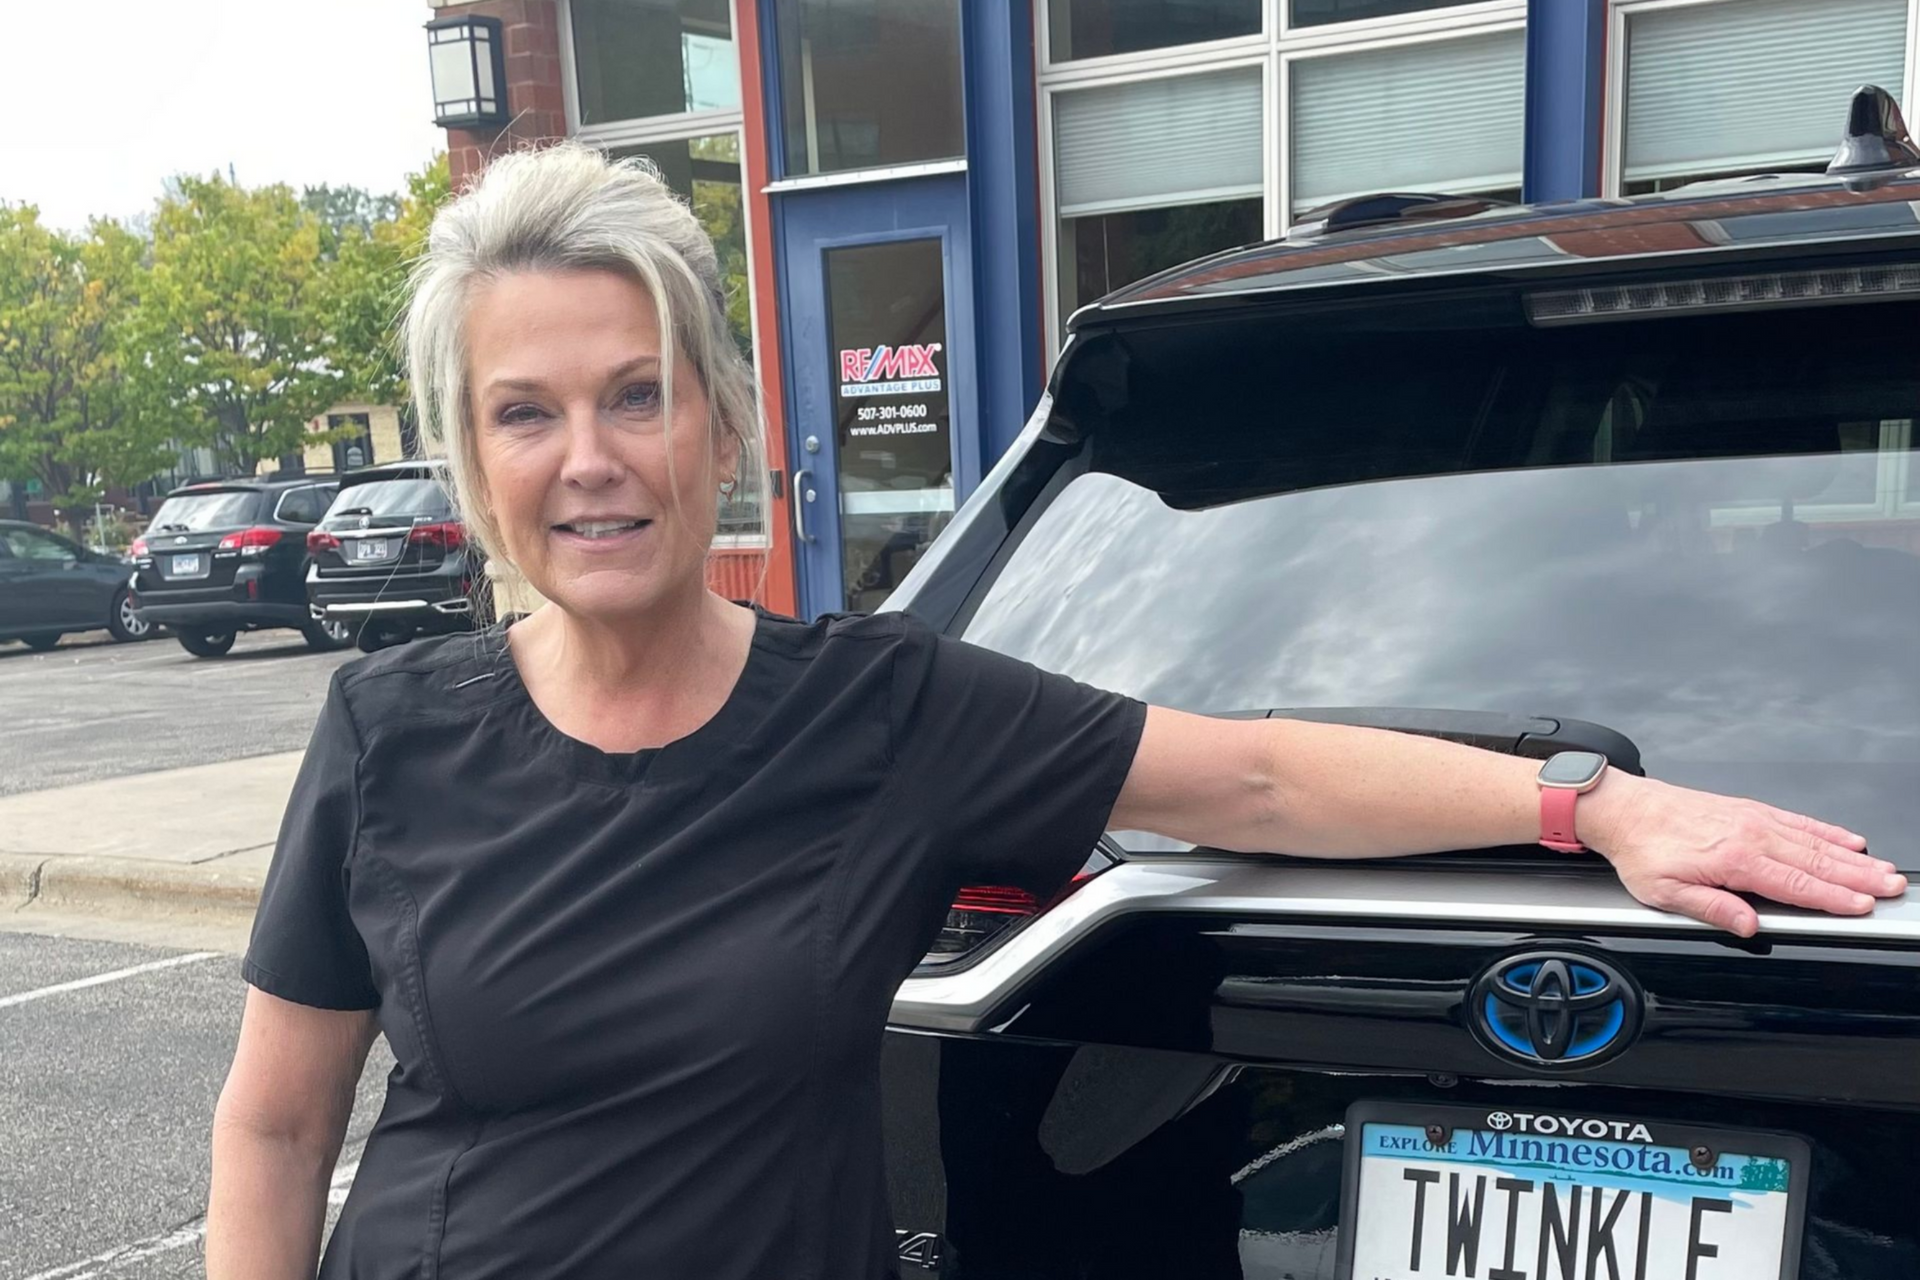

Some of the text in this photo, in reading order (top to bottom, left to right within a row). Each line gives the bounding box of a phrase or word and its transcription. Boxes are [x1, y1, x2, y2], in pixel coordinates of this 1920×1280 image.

[841, 344, 940, 382] RE/MAX
[843, 380, 939, 395] ADVANTAGE PLUS
[857, 404, 927, 420] 507-301-0600
[850, 422, 937, 436] www.ADVPLUS.com
[1513, 1113, 1653, 1142] TOYOTA
